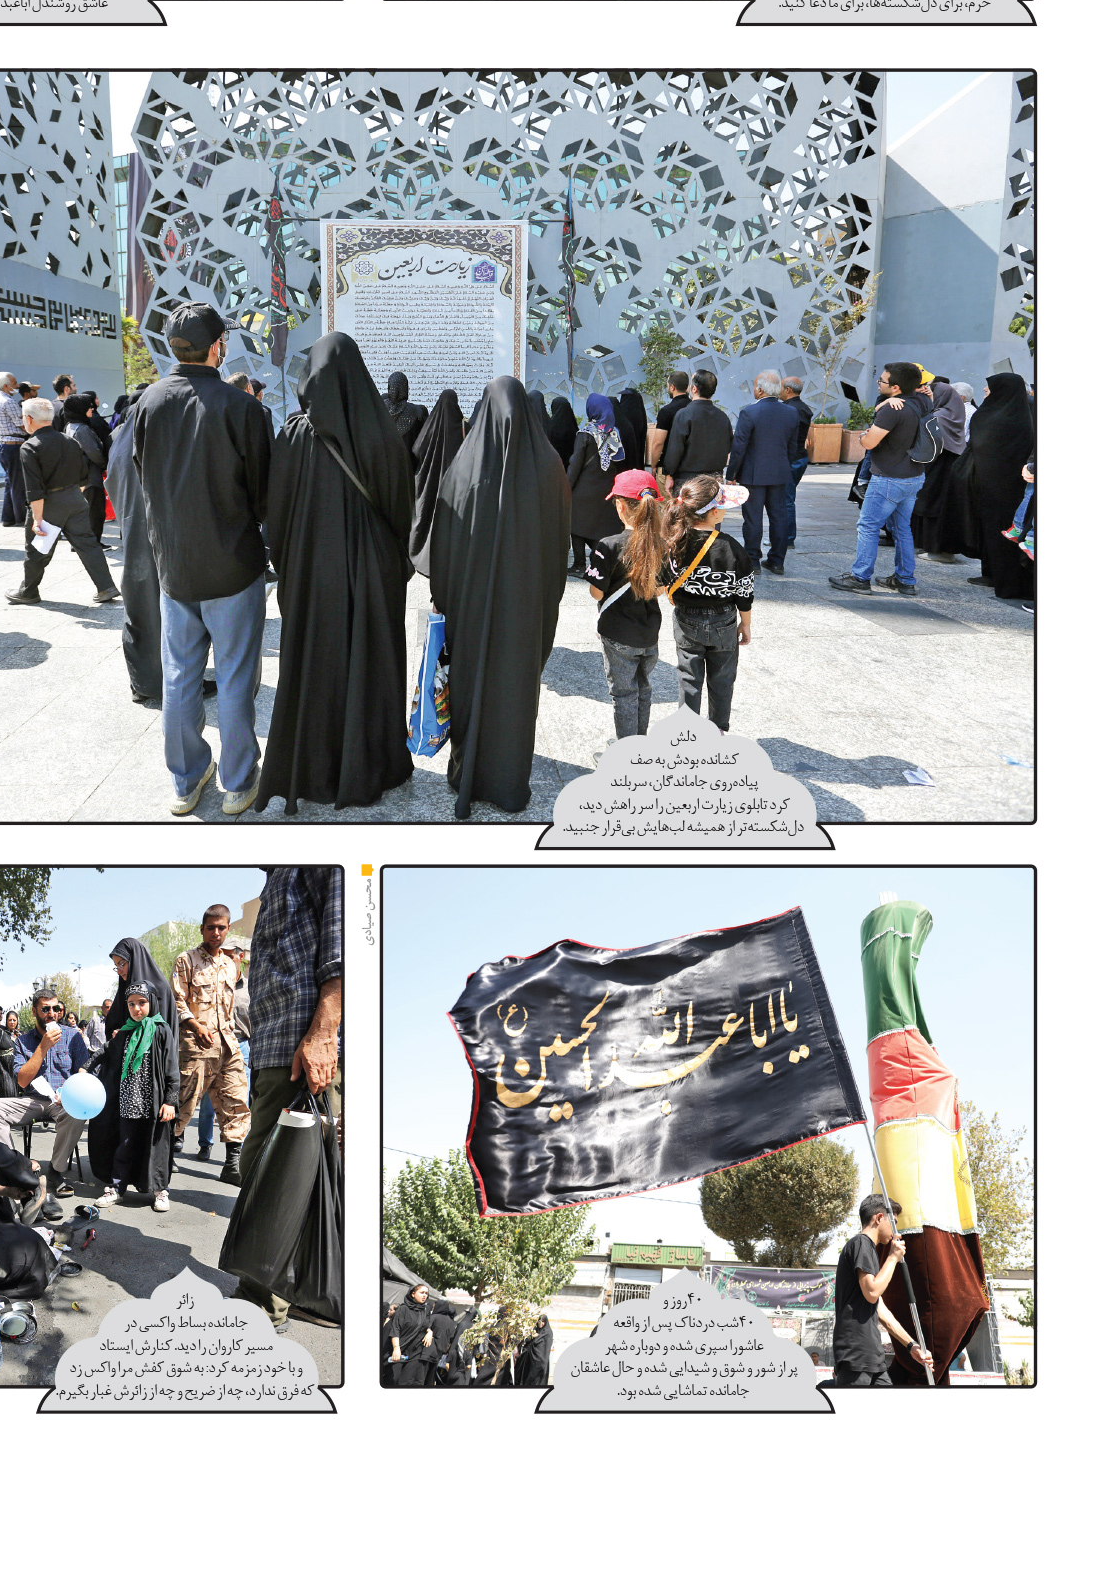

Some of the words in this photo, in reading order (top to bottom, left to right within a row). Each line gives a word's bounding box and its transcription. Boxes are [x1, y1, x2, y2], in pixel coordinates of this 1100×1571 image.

[378, 256, 425, 281] اربعین
[426, 257, 473, 280] زیارت
[671, 730, 696, 746] دلش
[631, 754, 653, 764] صف
[656, 757, 665, 768] به
[667, 754, 699, 769] بودش
[701, 753, 739, 764] کشانده
[366, 879, 375, 910] محسن
[362, 913, 374, 945] صیادی
[177, 1293, 194, 1309] زائر
[125, 1320, 137, 1332] در
[139, 1316, 175, 1332] واکسی
[178, 1316, 206, 1331] بساط
[208, 1316, 247, 1330] جامانده
[639, 1385, 661, 1395] شده
[664, 1385, 707, 1400] تماشایی
[710, 1385, 749, 1398] جامانده
